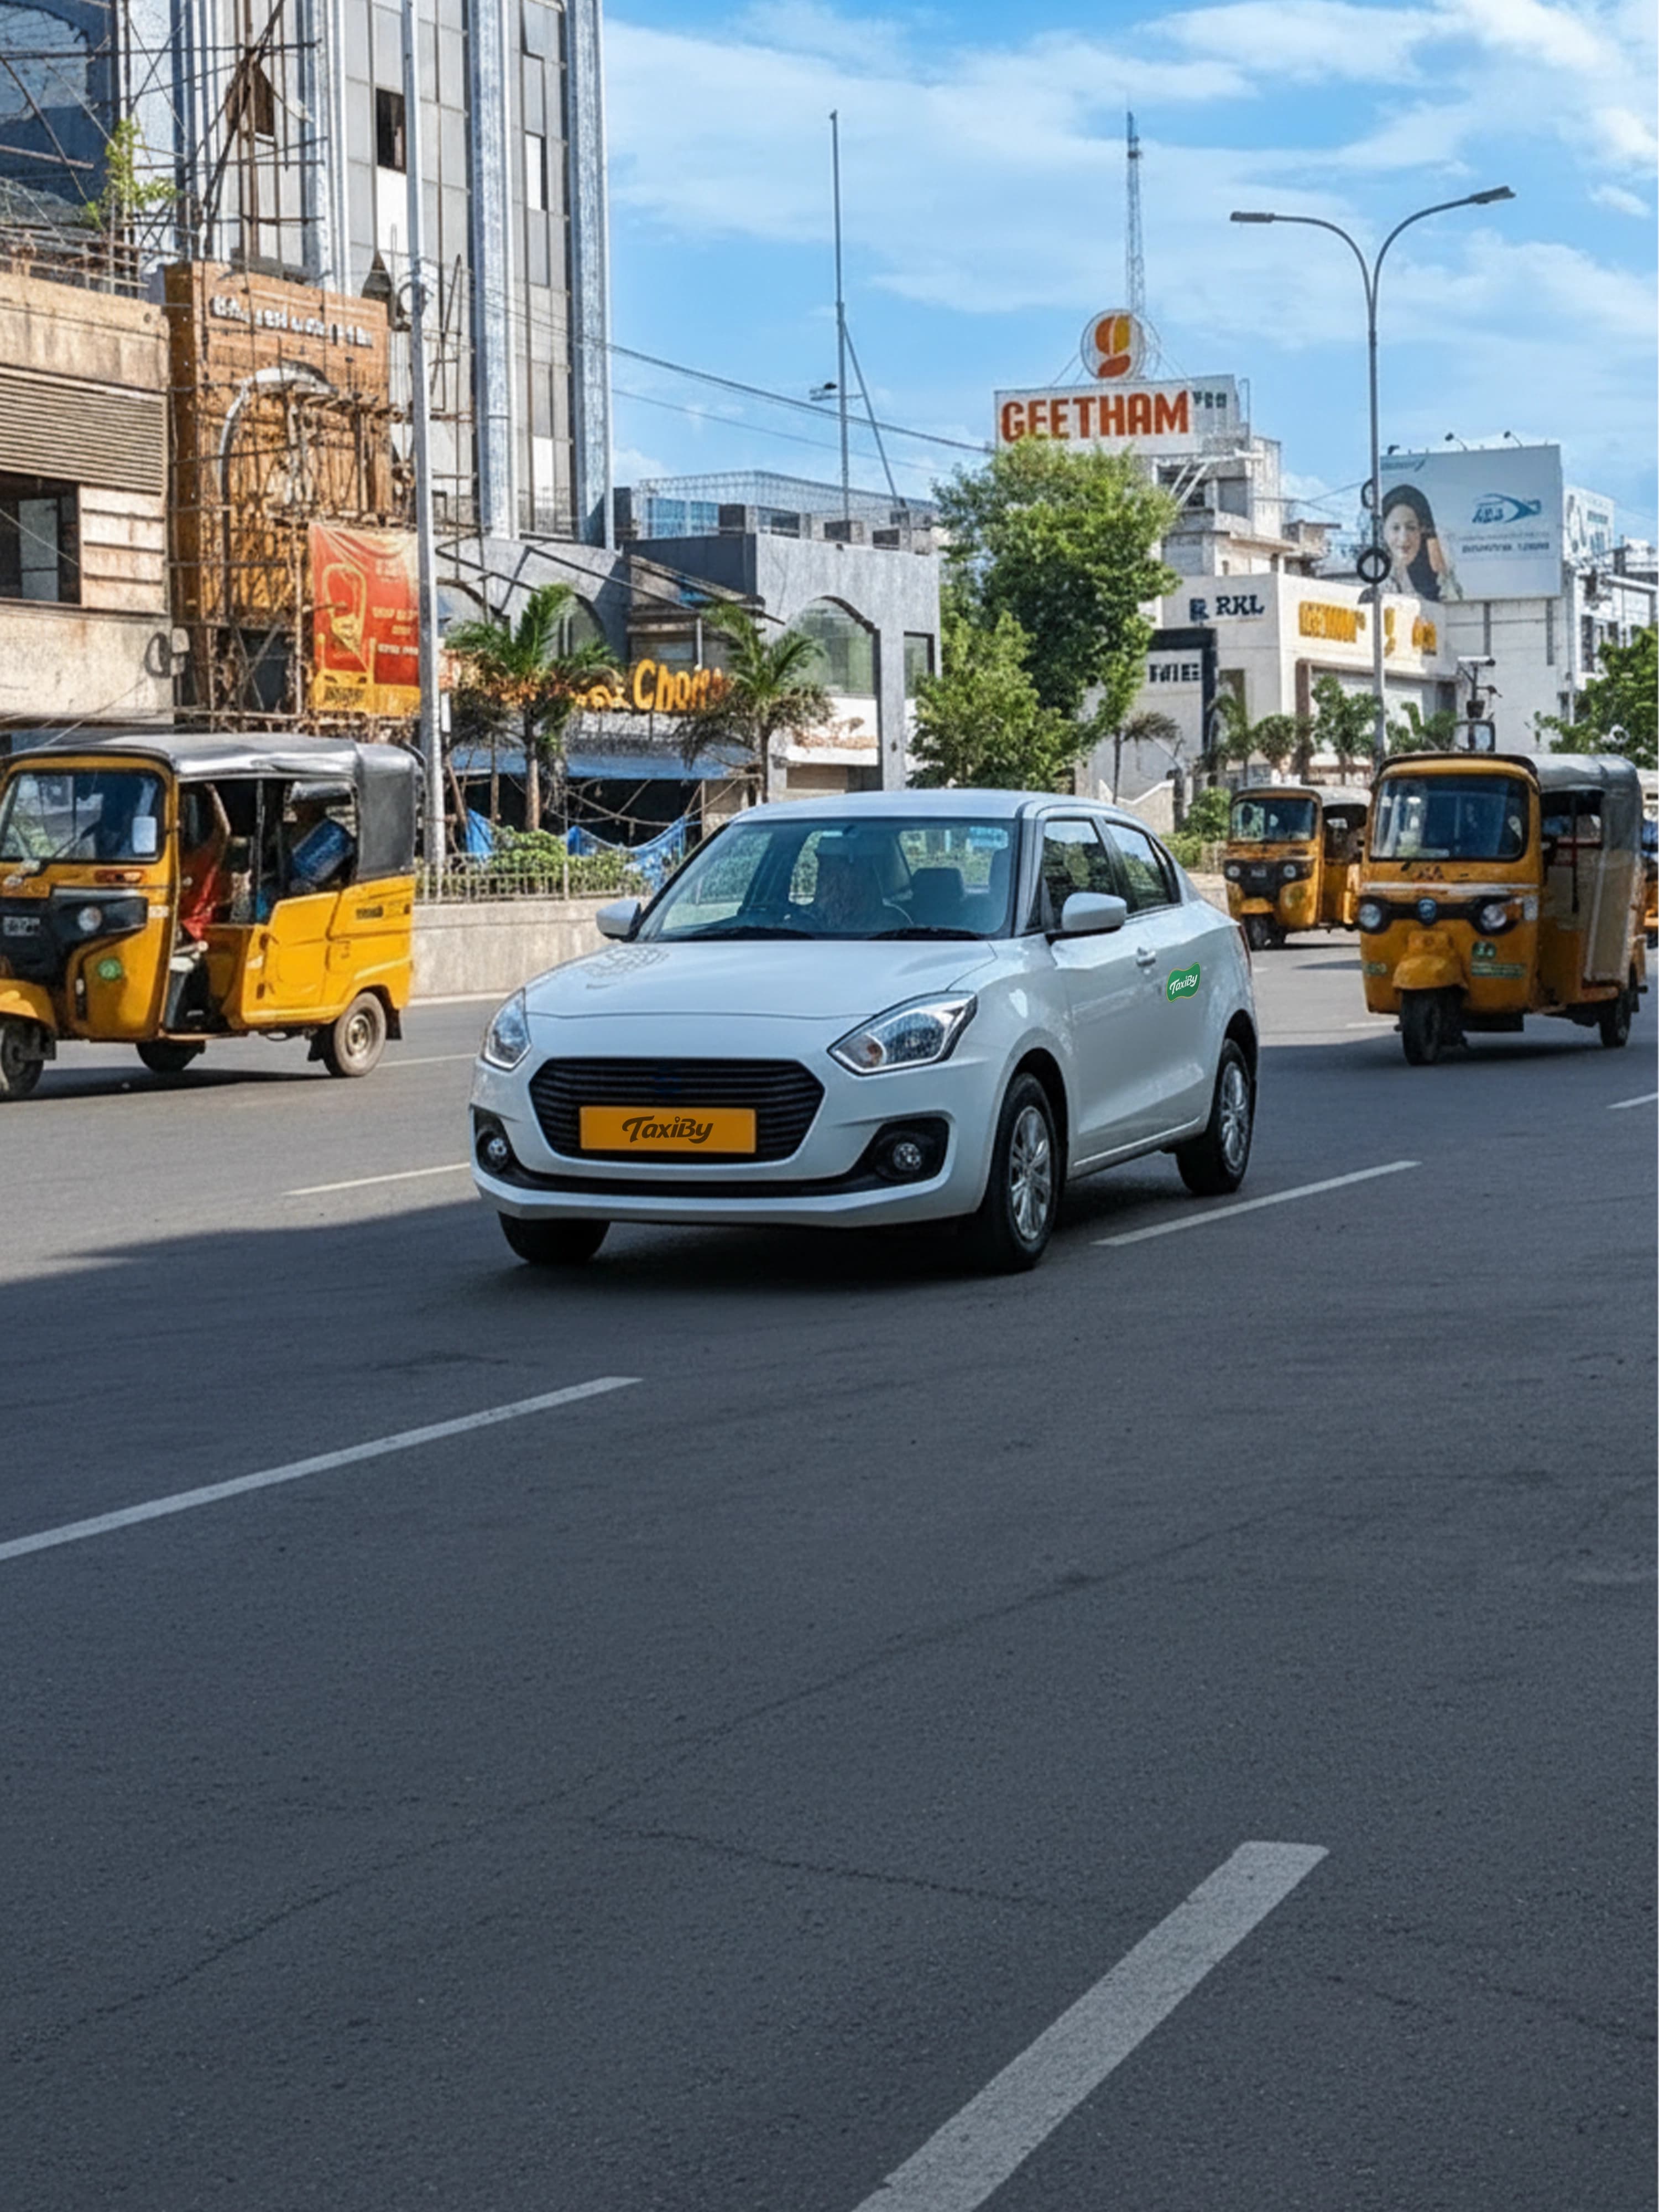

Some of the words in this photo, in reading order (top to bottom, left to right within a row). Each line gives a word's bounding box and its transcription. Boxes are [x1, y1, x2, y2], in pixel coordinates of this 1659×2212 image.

[1001, 390, 1189, 444] GEETHAM
[1215, 594, 1265, 616] RKL
[1169, 974, 1198, 995] TaxiBy
[622, 1115, 714, 1144] TaxiBy
